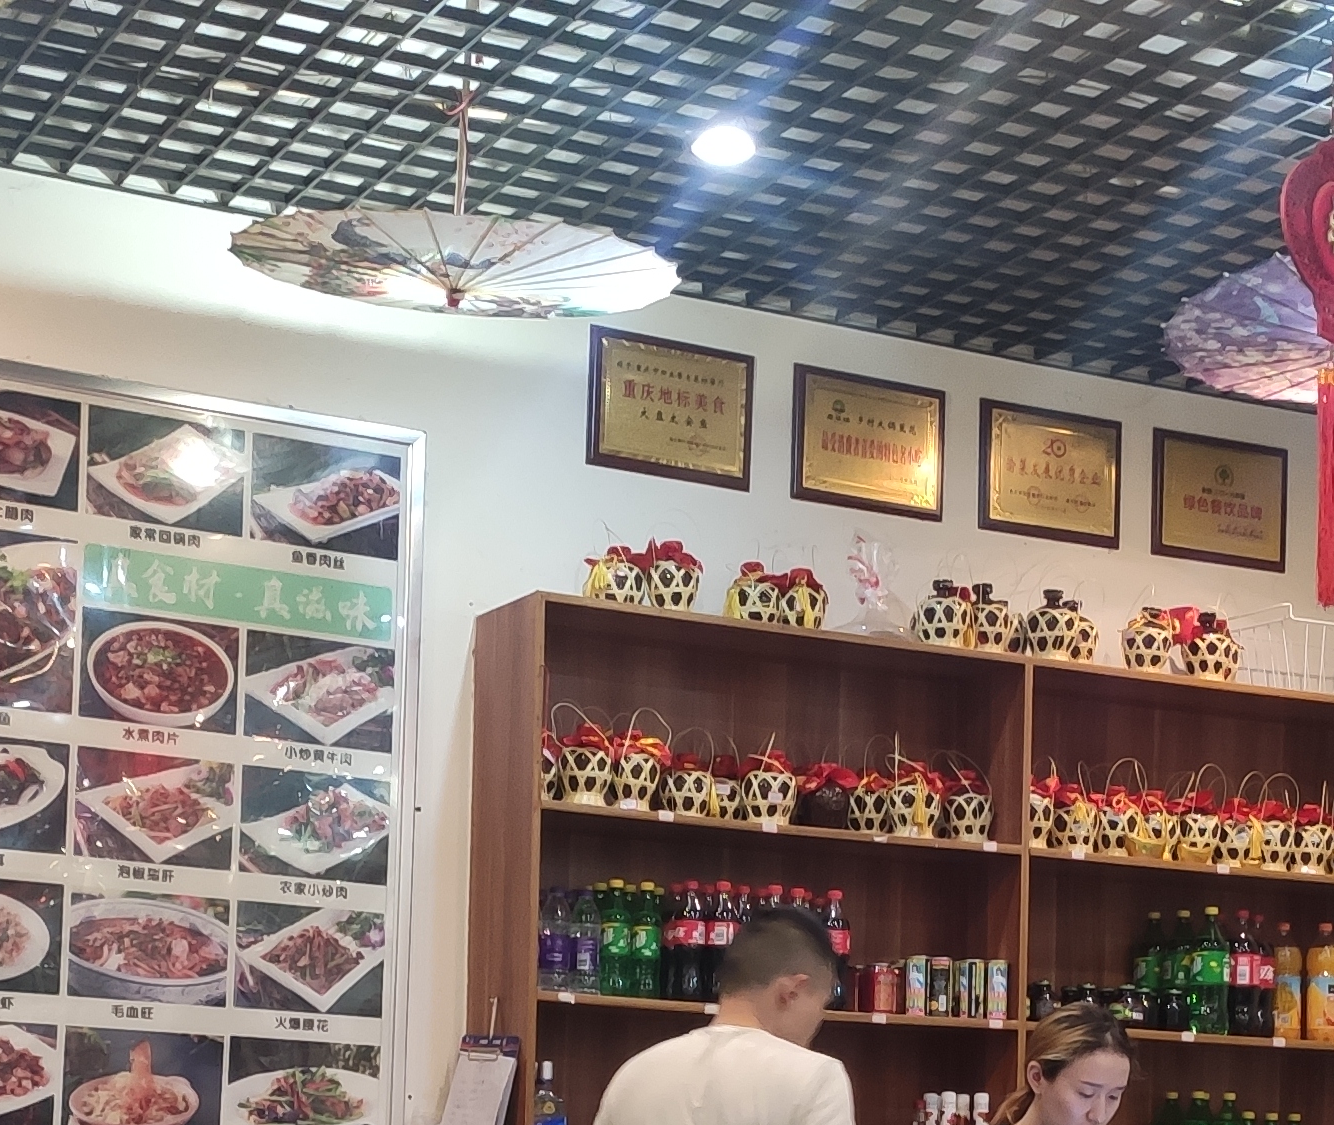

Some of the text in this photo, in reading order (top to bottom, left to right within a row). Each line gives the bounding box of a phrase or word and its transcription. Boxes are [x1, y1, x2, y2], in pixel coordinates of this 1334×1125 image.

[622, 378, 727, 415] 重庆地标美食
[128, 525, 202, 549] 家常回锅肉
[290, 549, 347, 571] 鱼香肉丝
[121, 726, 180, 747] 水煮肉片
[283, 744, 353, 768] 小炒黄牛肉
[279, 880, 349, 900] 农家小炒肉
[110, 1003, 156, 1021] 毛血旺
[274, 1015, 330, 1034] 火爆腰花
